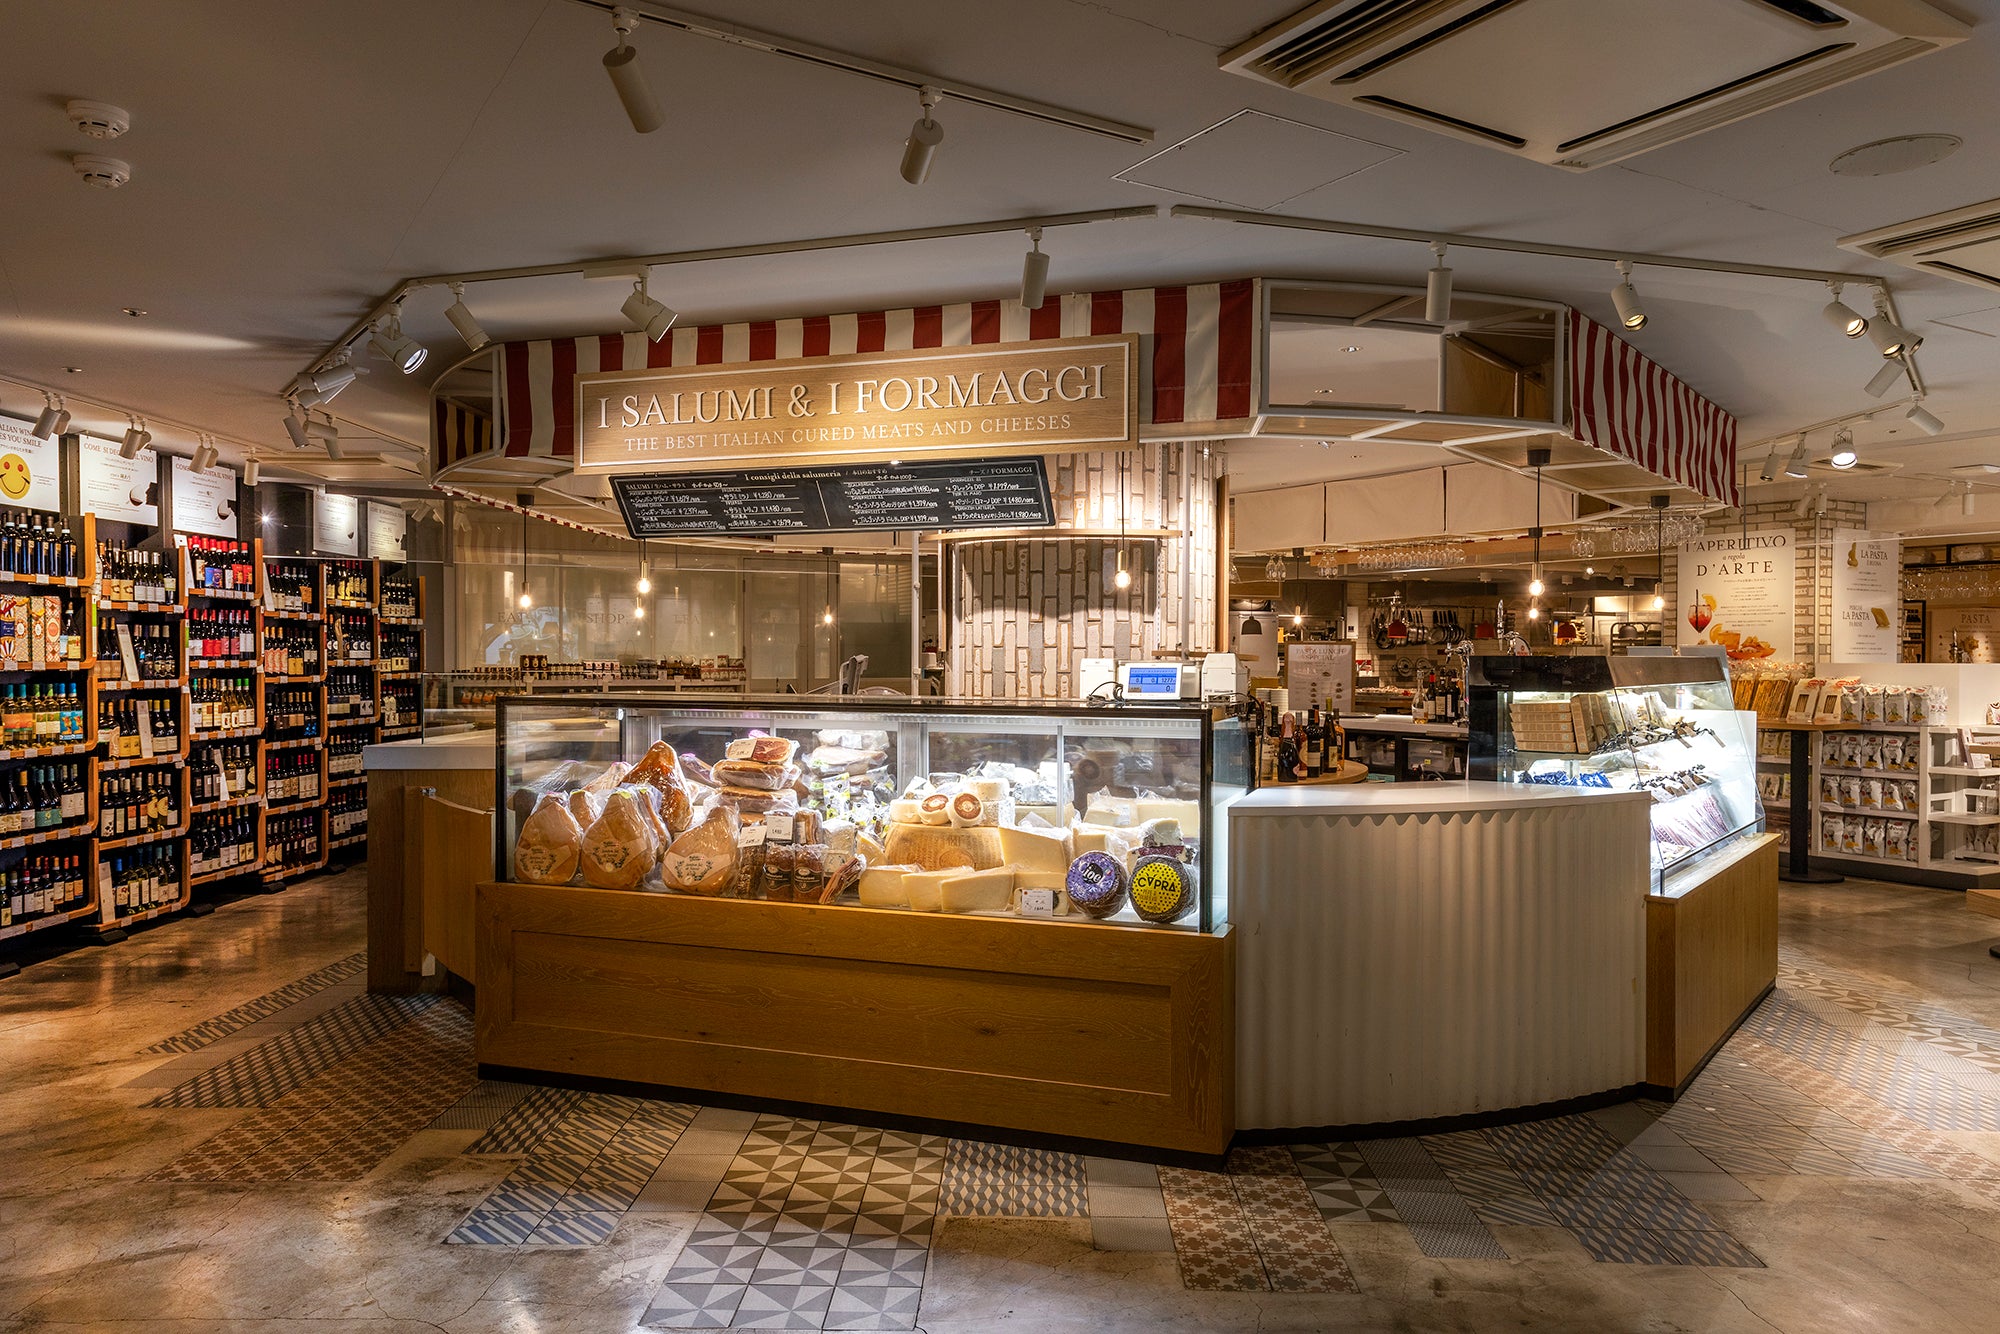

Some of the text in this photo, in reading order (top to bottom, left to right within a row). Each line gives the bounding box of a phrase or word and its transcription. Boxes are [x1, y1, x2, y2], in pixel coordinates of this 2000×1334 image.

[598, 364, 1107, 428] I SALUMI & I FORMAGGI
[625, 415, 1071, 451] THE BEST ITALIAN CURED MEATS AND CHEESES
[750, 472, 780, 483] consigli
[781, 472, 801, 480] della
[801, 470, 841, 479] salumeria
[991, 466, 1033, 475] FORMAGGI
[1727, 552, 1746, 562] regola
[1860, 549, 1889, 561] LA PASTA
[1696, 561, 1773, 577] D'ARTE
[587, 613, 629, 625] SHOP.
[1842, 611, 1870, 621] LA PASTA
[1961, 613, 1990, 624] PASTA
